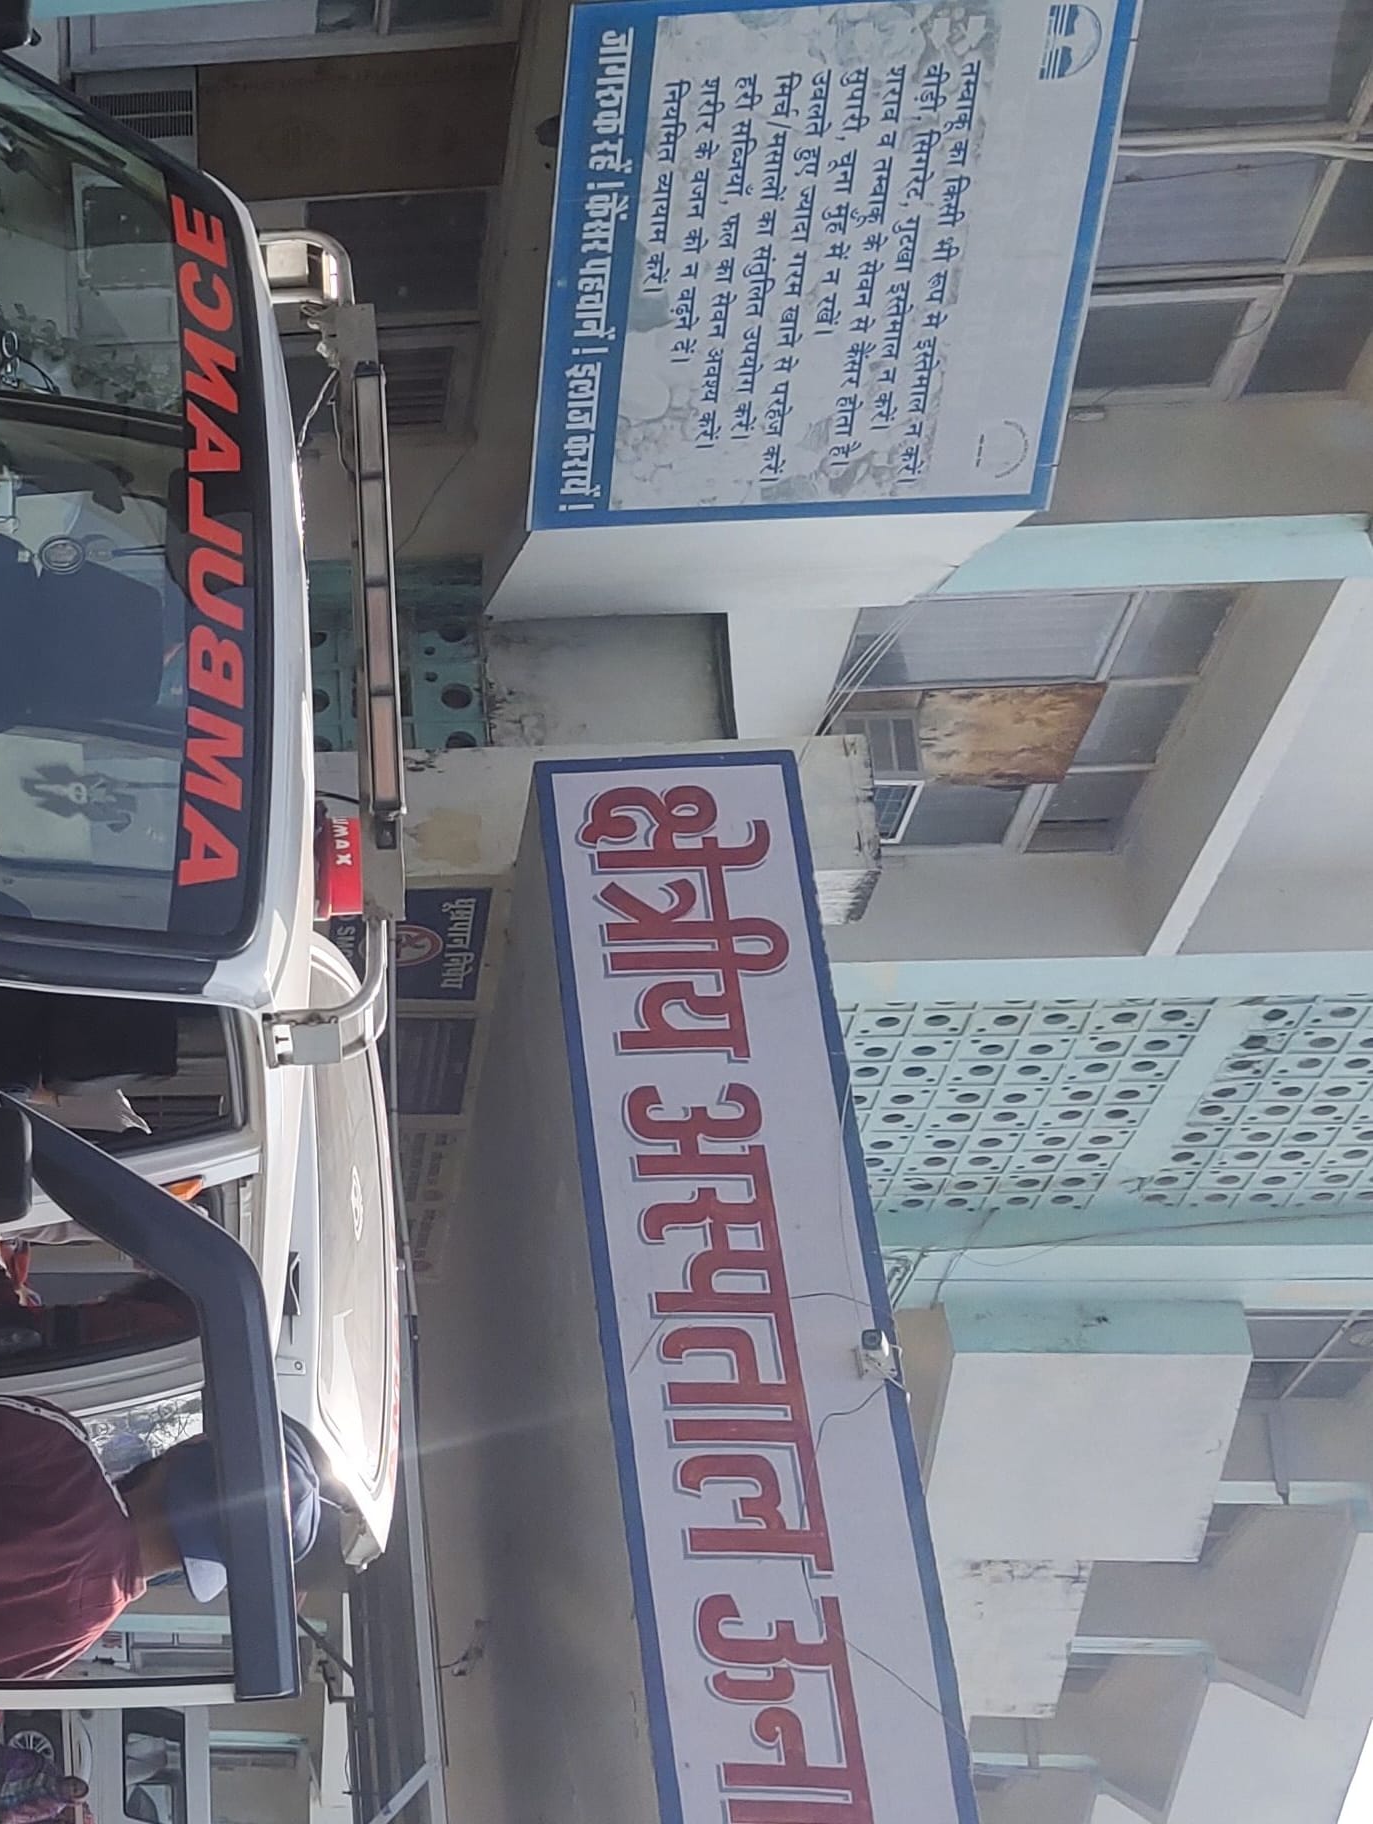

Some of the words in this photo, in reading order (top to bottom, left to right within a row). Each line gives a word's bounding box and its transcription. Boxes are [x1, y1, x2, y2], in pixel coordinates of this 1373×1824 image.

[695, 76, 726, 134] शरीर
[735, 74, 763, 111] हरी
[657, 80, 691, 163] नियमित
[877, 131, 897, 149] व
[588, 138, 633, 174] रहें
[694, 140, 720, 160] के
[794, 146, 821, 177] हुए
[827, 149, 858, 195] चूना
[948, 139, 969, 166] का
[648, 171, 674, 244] व्यायाम
[687, 168, 710, 220] वजन
[791, 184, 816, 243] ज्यादा
[938, 176, 970, 227] किसी
[683, 227, 709, 254] को
[718, 213, 740, 249] फल
[755, 209, 777, 237] का
[862, 232, 888, 252] के
[892, 215, 920, 273] गुटखा
[680, 262, 699, 279] न
[714, 258, 736, 283] का
[825, 242, 850, 260] में
[932, 237, 959, 263] भी
[743, 244, 776, 317] संतुलित
[784, 251, 807, 297] गरम
[821, 268, 840, 285] न
[853, 259, 885, 308] सेवन
[926, 270, 948, 304] रूप
[573, 256, 616, 341] पहचानें
[708, 291, 737, 339] सेवन
[881, 281, 913, 360] इस्तेमाल
[777, 305, 803, 348] खाने
[850, 316, 875, 333] से
[701, 349, 724, 404] अवश्य
[736, 325, 763, 394] उपयोग
[773, 355, 800, 373] से
[841, 341, 877, 388] कैंसर
[877, 368, 896, 384] न
[908, 336, 940, 415] इस्तेमाल
[564, 362, 602, 432] इलाज
[765, 380, 793, 437] परहेज
[835, 394, 864, 436] होता
[904, 421, 923, 438] न
[559, 433, 601, 497] करायें
[331, 817, 353, 866] UMAX
[578, 786, 790, 1064] क्षेत्रीय
[623, 1082, 835, 1580] अस्पताल
[692, 1594, 875, 1824] ऊना
